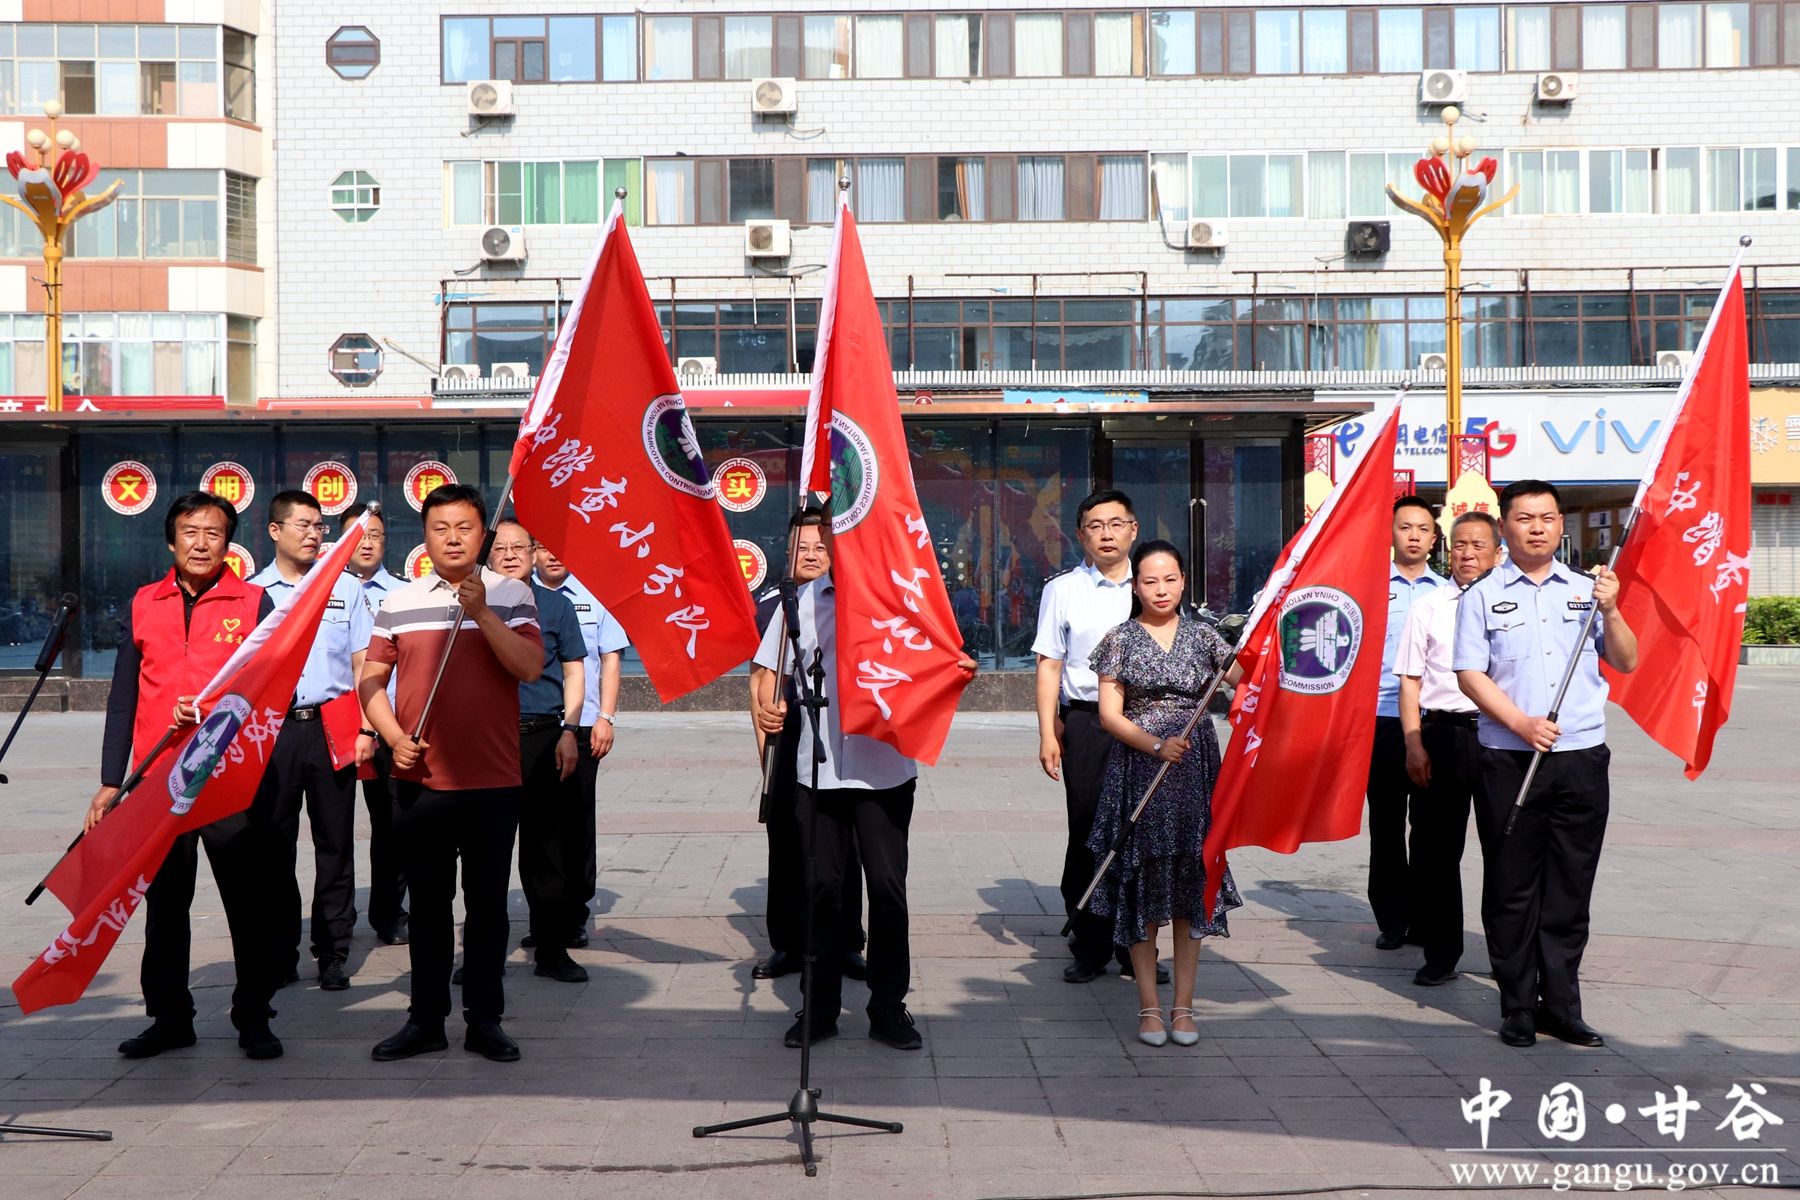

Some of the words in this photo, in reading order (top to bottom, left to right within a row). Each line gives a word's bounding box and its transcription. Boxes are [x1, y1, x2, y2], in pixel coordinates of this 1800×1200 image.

[1465, 417, 1517, 458] 5G
[1541, 407, 1661, 454] viv
[726, 471, 752, 498] 实
[1282, 592, 1313, 610] NATION
